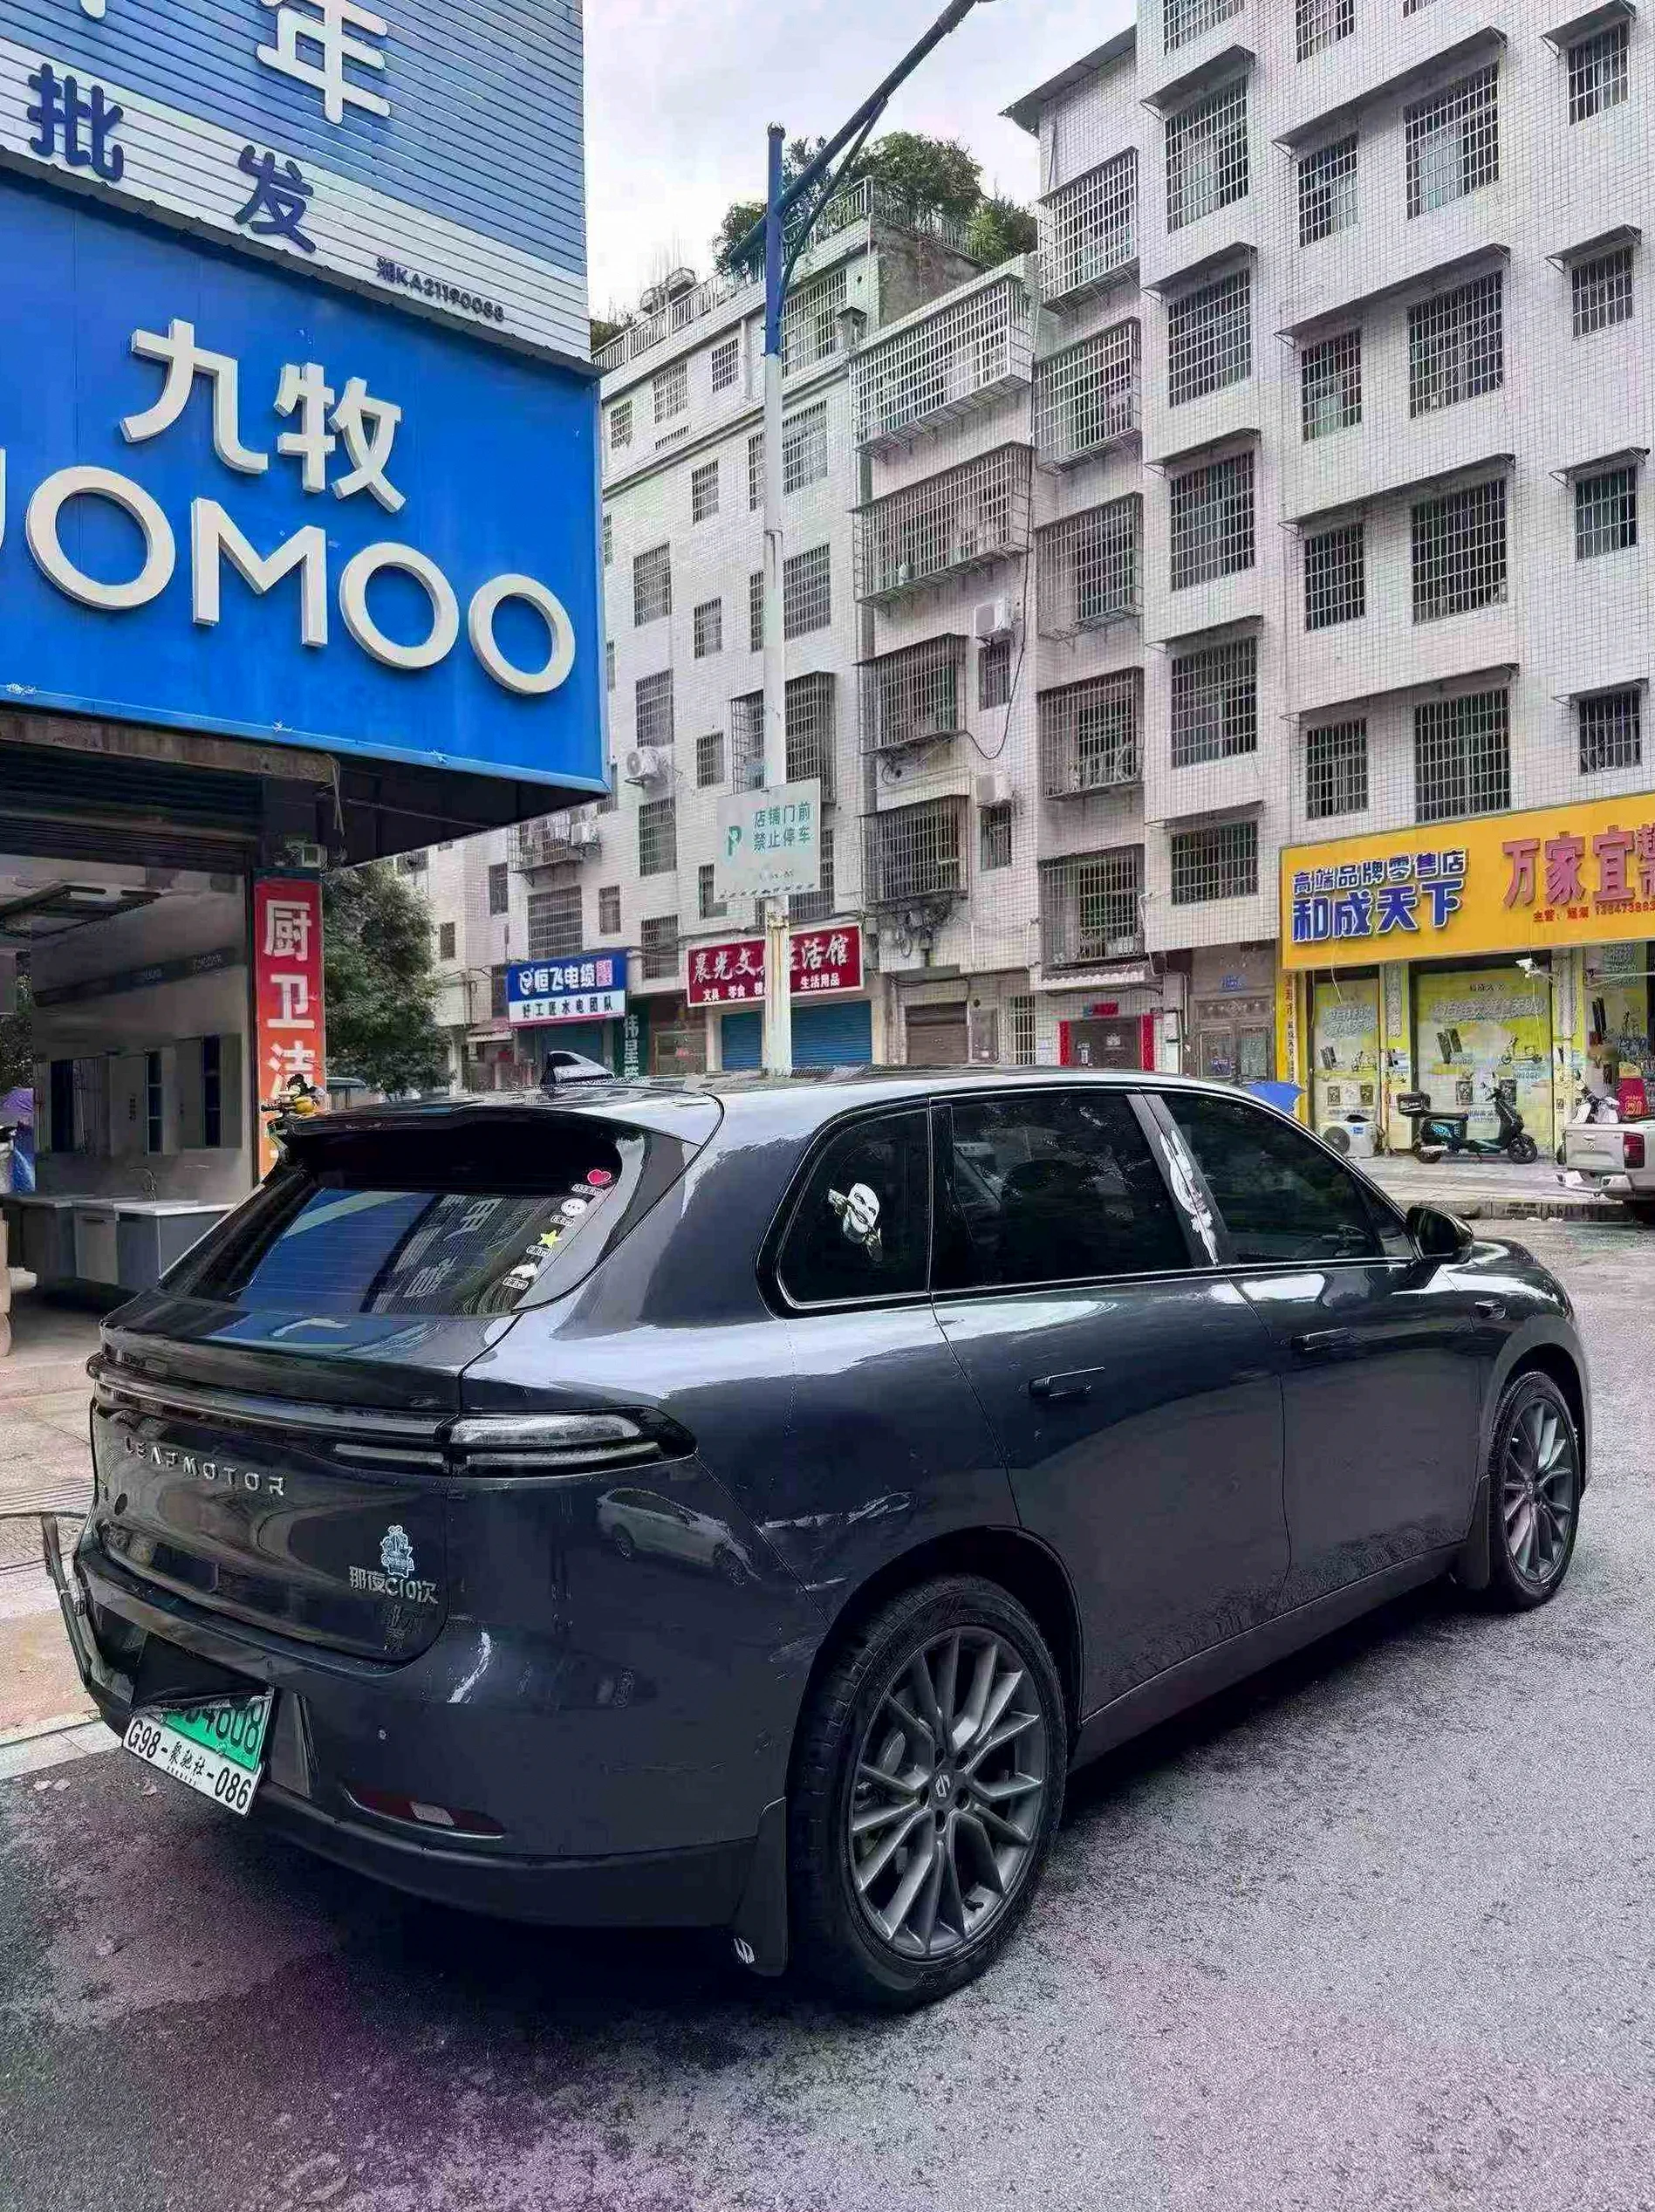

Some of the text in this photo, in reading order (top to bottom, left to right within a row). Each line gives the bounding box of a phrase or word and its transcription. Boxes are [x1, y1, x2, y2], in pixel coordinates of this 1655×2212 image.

[27, 62, 317, 253] 批发
[120, 318, 407, 513] 九牧
[0, 448, 576, 695] OMOO
[754, 802, 810, 828] 店铺门前
[753, 827, 810, 854] 禁止停车
[1292, 848, 1466, 895] 高端品牌零售店
[1501, 824, 1636, 908] 万家宜
[1291, 878, 1465, 942] 和成天下
[534, 963, 595, 992] 恒飞电缆
[693, 934, 849, 983] 晨光文活馆
[800, 972, 840, 990] 生活用品
